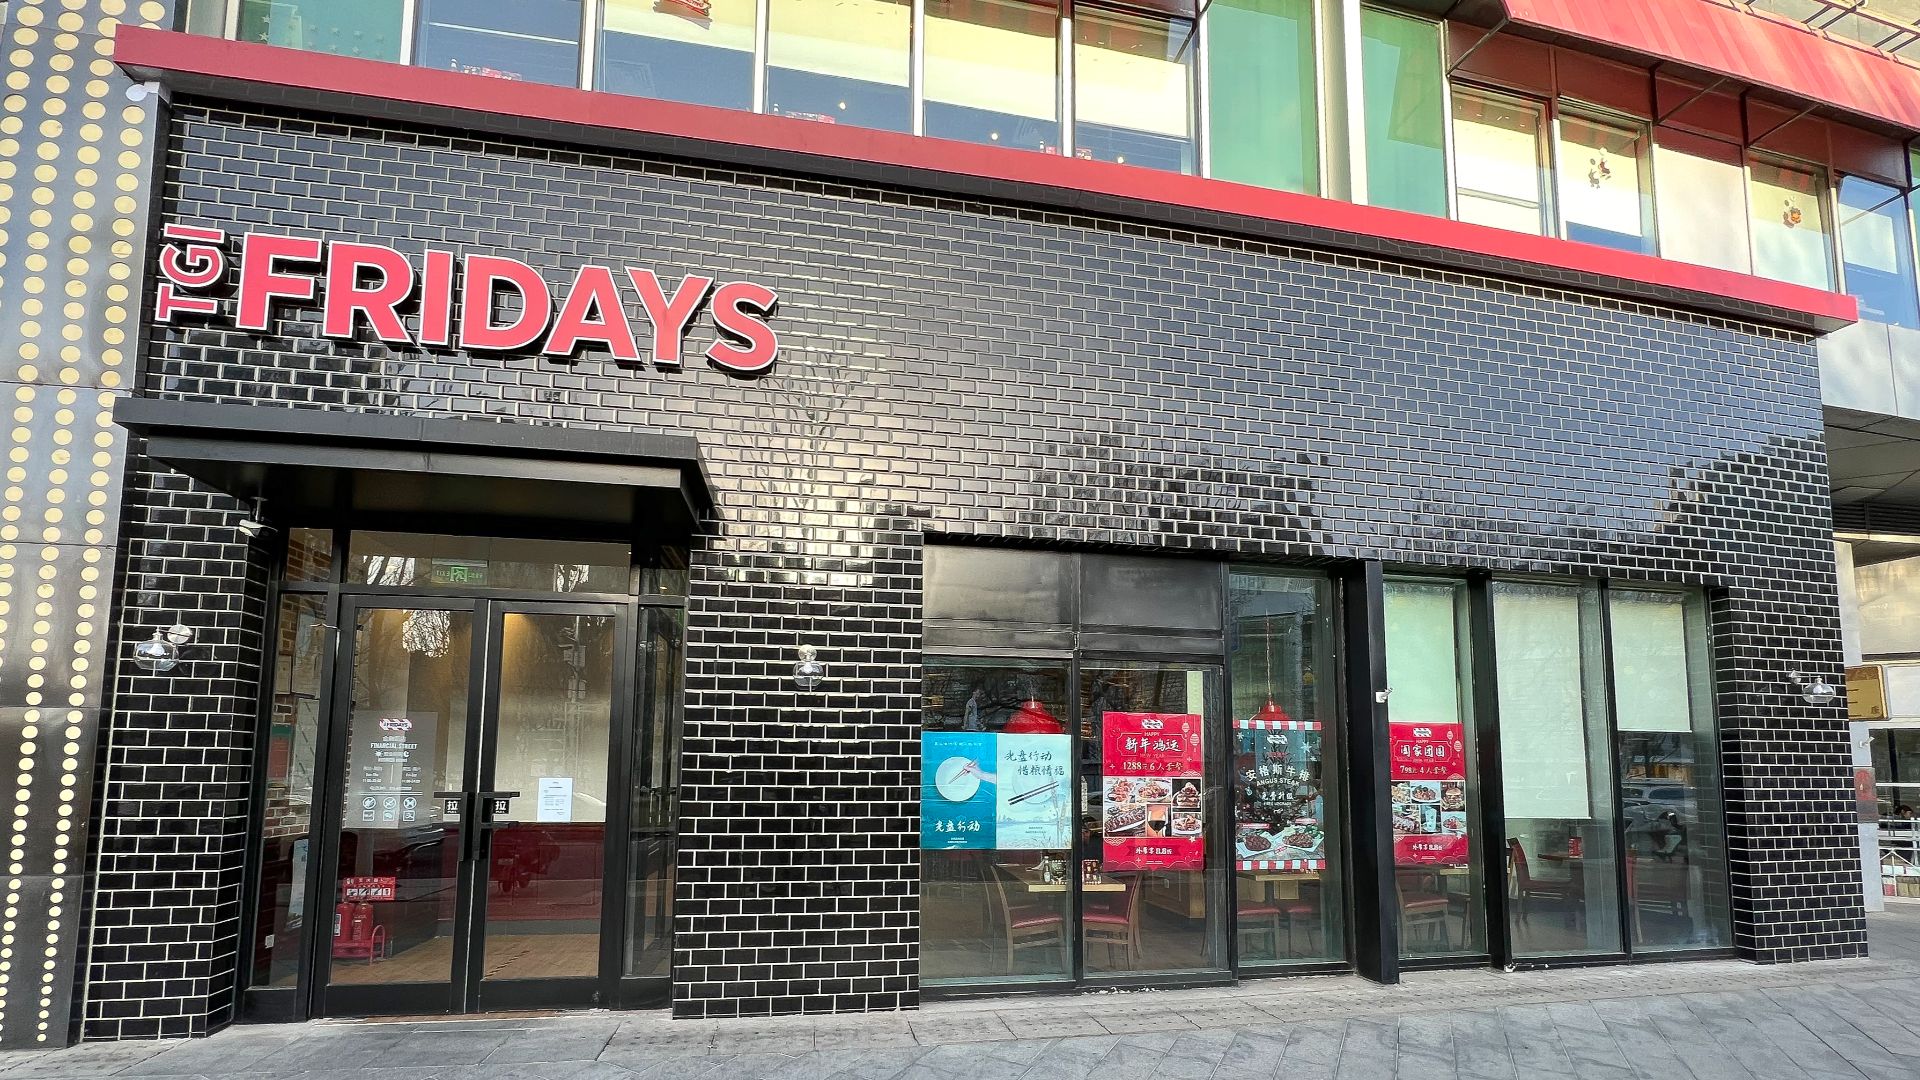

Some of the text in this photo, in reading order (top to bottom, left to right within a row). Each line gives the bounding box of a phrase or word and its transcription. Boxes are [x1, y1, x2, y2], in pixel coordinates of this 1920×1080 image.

[154, 222, 779, 371] TGI FRIDAYS
[1124, 736, 1182, 753] 新年鸿运
[1003, 749, 1053, 763] 光盘行动
[1256, 777, 1300, 787] ANGUS STEAK
[446, 800, 459, 811] 拉
[495, 800, 507, 811] 拉
[935, 819, 981, 833] 光盘行动
